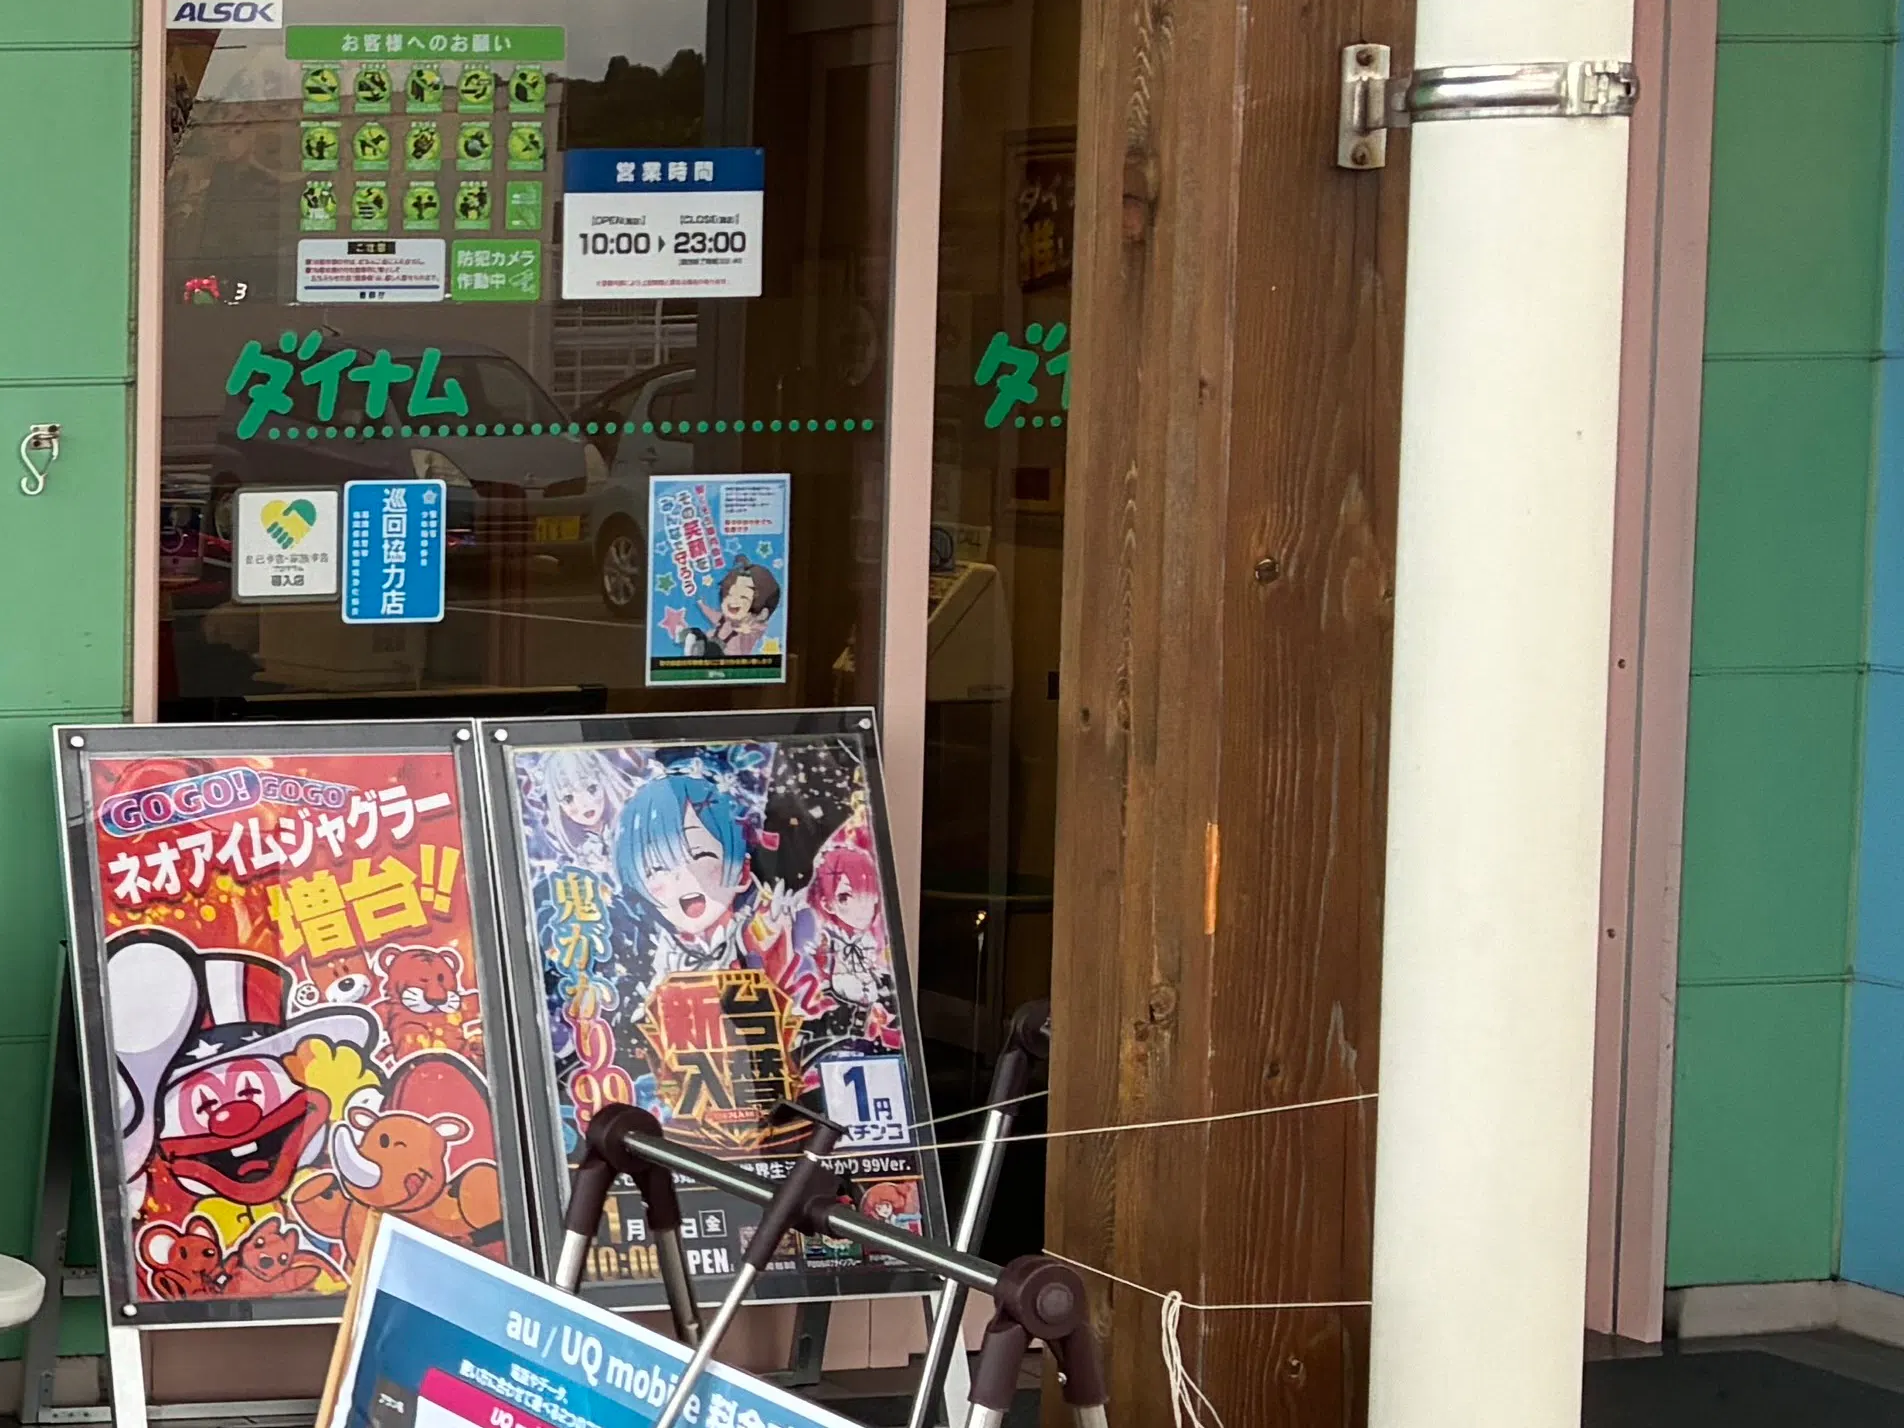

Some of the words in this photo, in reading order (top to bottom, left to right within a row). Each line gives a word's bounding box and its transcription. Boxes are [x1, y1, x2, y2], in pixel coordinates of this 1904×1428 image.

[173, 2, 275, 23] ALSOK
[342, 33, 512, 52] お客様へのお願い
[616, 161, 714, 183] 営業時間
[579, 232, 651, 256] 10:00
[674, 231, 746, 254] 23:00
[457, 249, 535, 267] 防犯カメラ
[457, 273, 505, 290] 作動中
[225, 329, 469, 440] ダイナム
[381, 488, 408, 616] 巡回協力店
[111, 774, 248, 829] GOGO!
[109, 785, 452, 905] ネオアイムジャグラー
[863, 1159, 910, 1173] 99Ver.
[686, 1248, 730, 1275] PEN.
[506, 1309, 542, 1350] au
[561, 1325, 603, 1387] UQ
